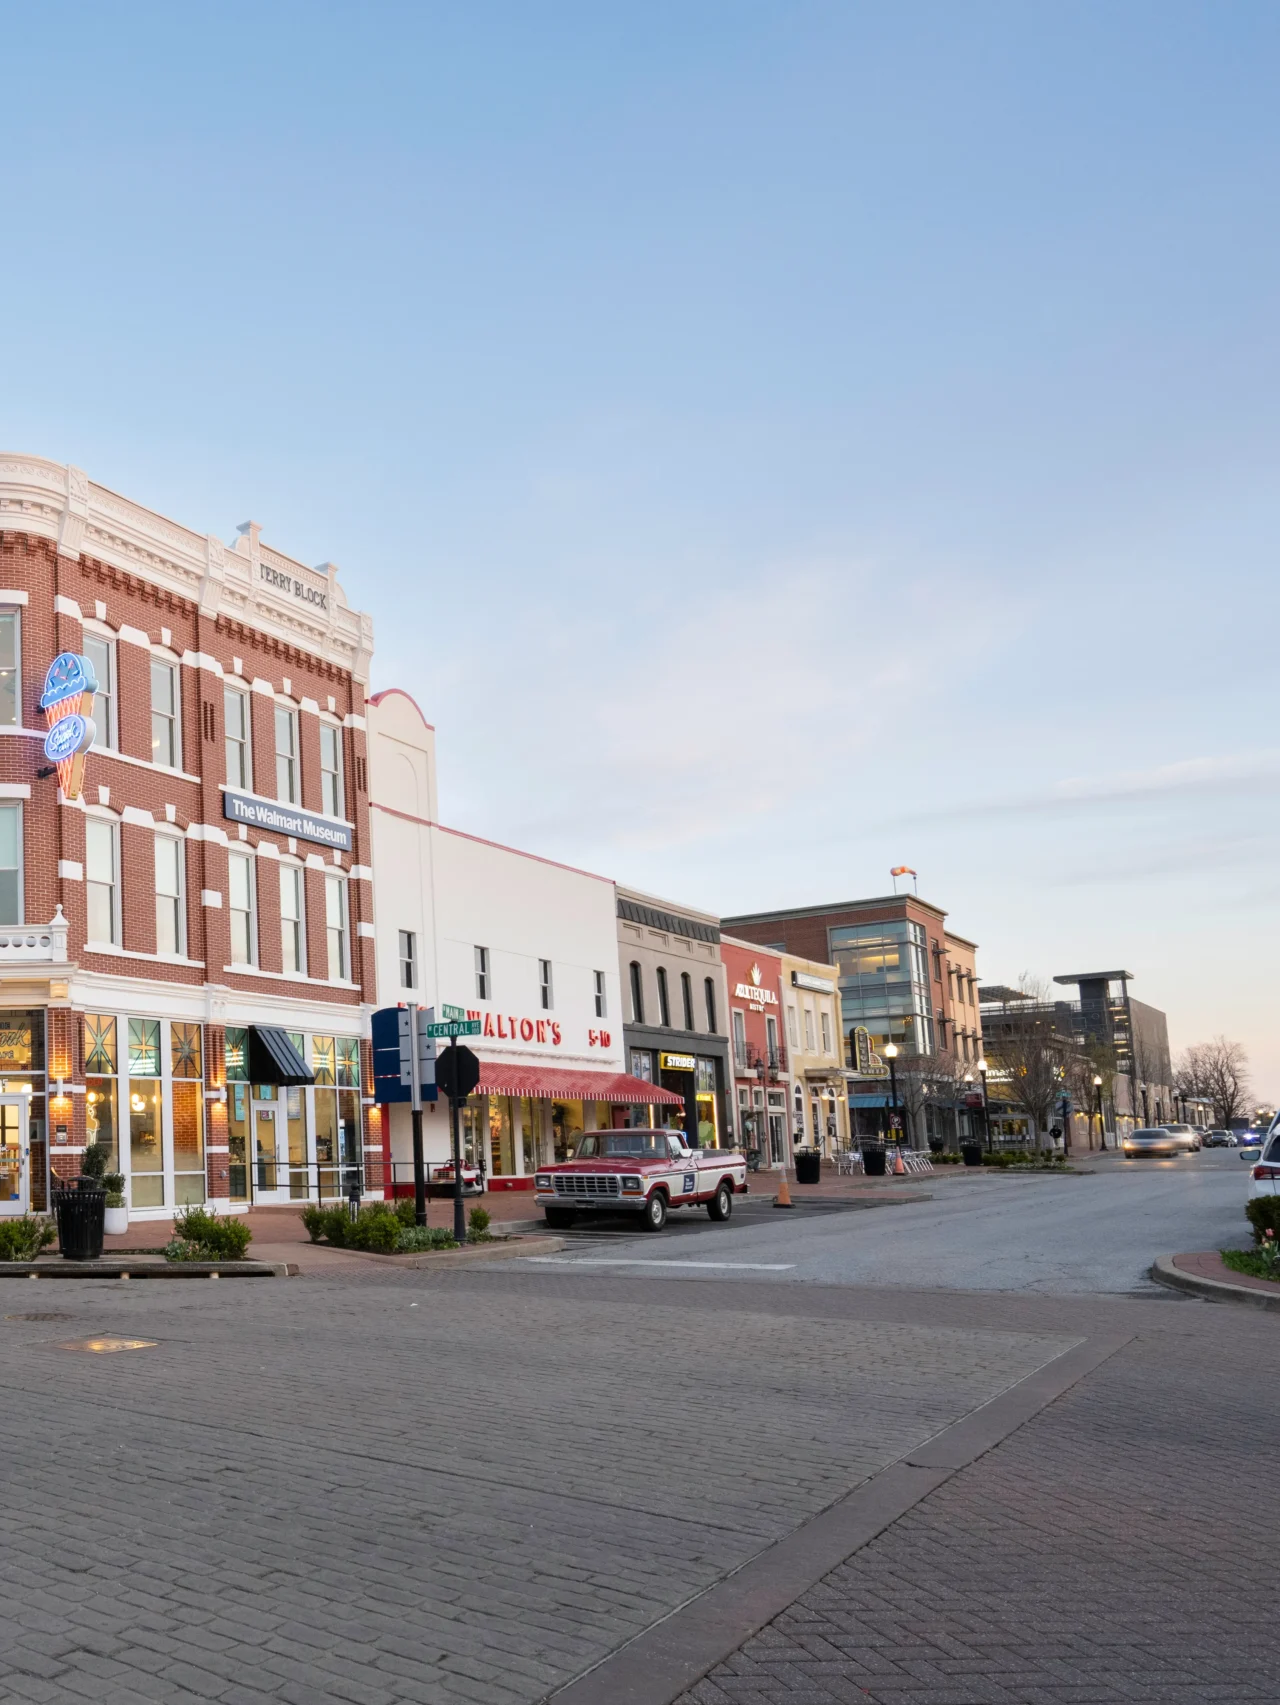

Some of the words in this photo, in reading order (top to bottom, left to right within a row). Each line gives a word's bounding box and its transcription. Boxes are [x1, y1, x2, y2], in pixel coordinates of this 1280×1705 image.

[260, 563, 291, 593] TERRY
[294, 580, 327, 610] BLOCK
[233, 799, 255, 820] The
[255, 806, 302, 833] Walmart
[303, 819, 348, 845] Museum
[445, 1006, 459, 1020] MAIN
[433, 1023, 470, 1036] CENTRAL
[588, 1029, 611, 1048] 5-10
[666, 1055, 696, 1069] STRIDER
